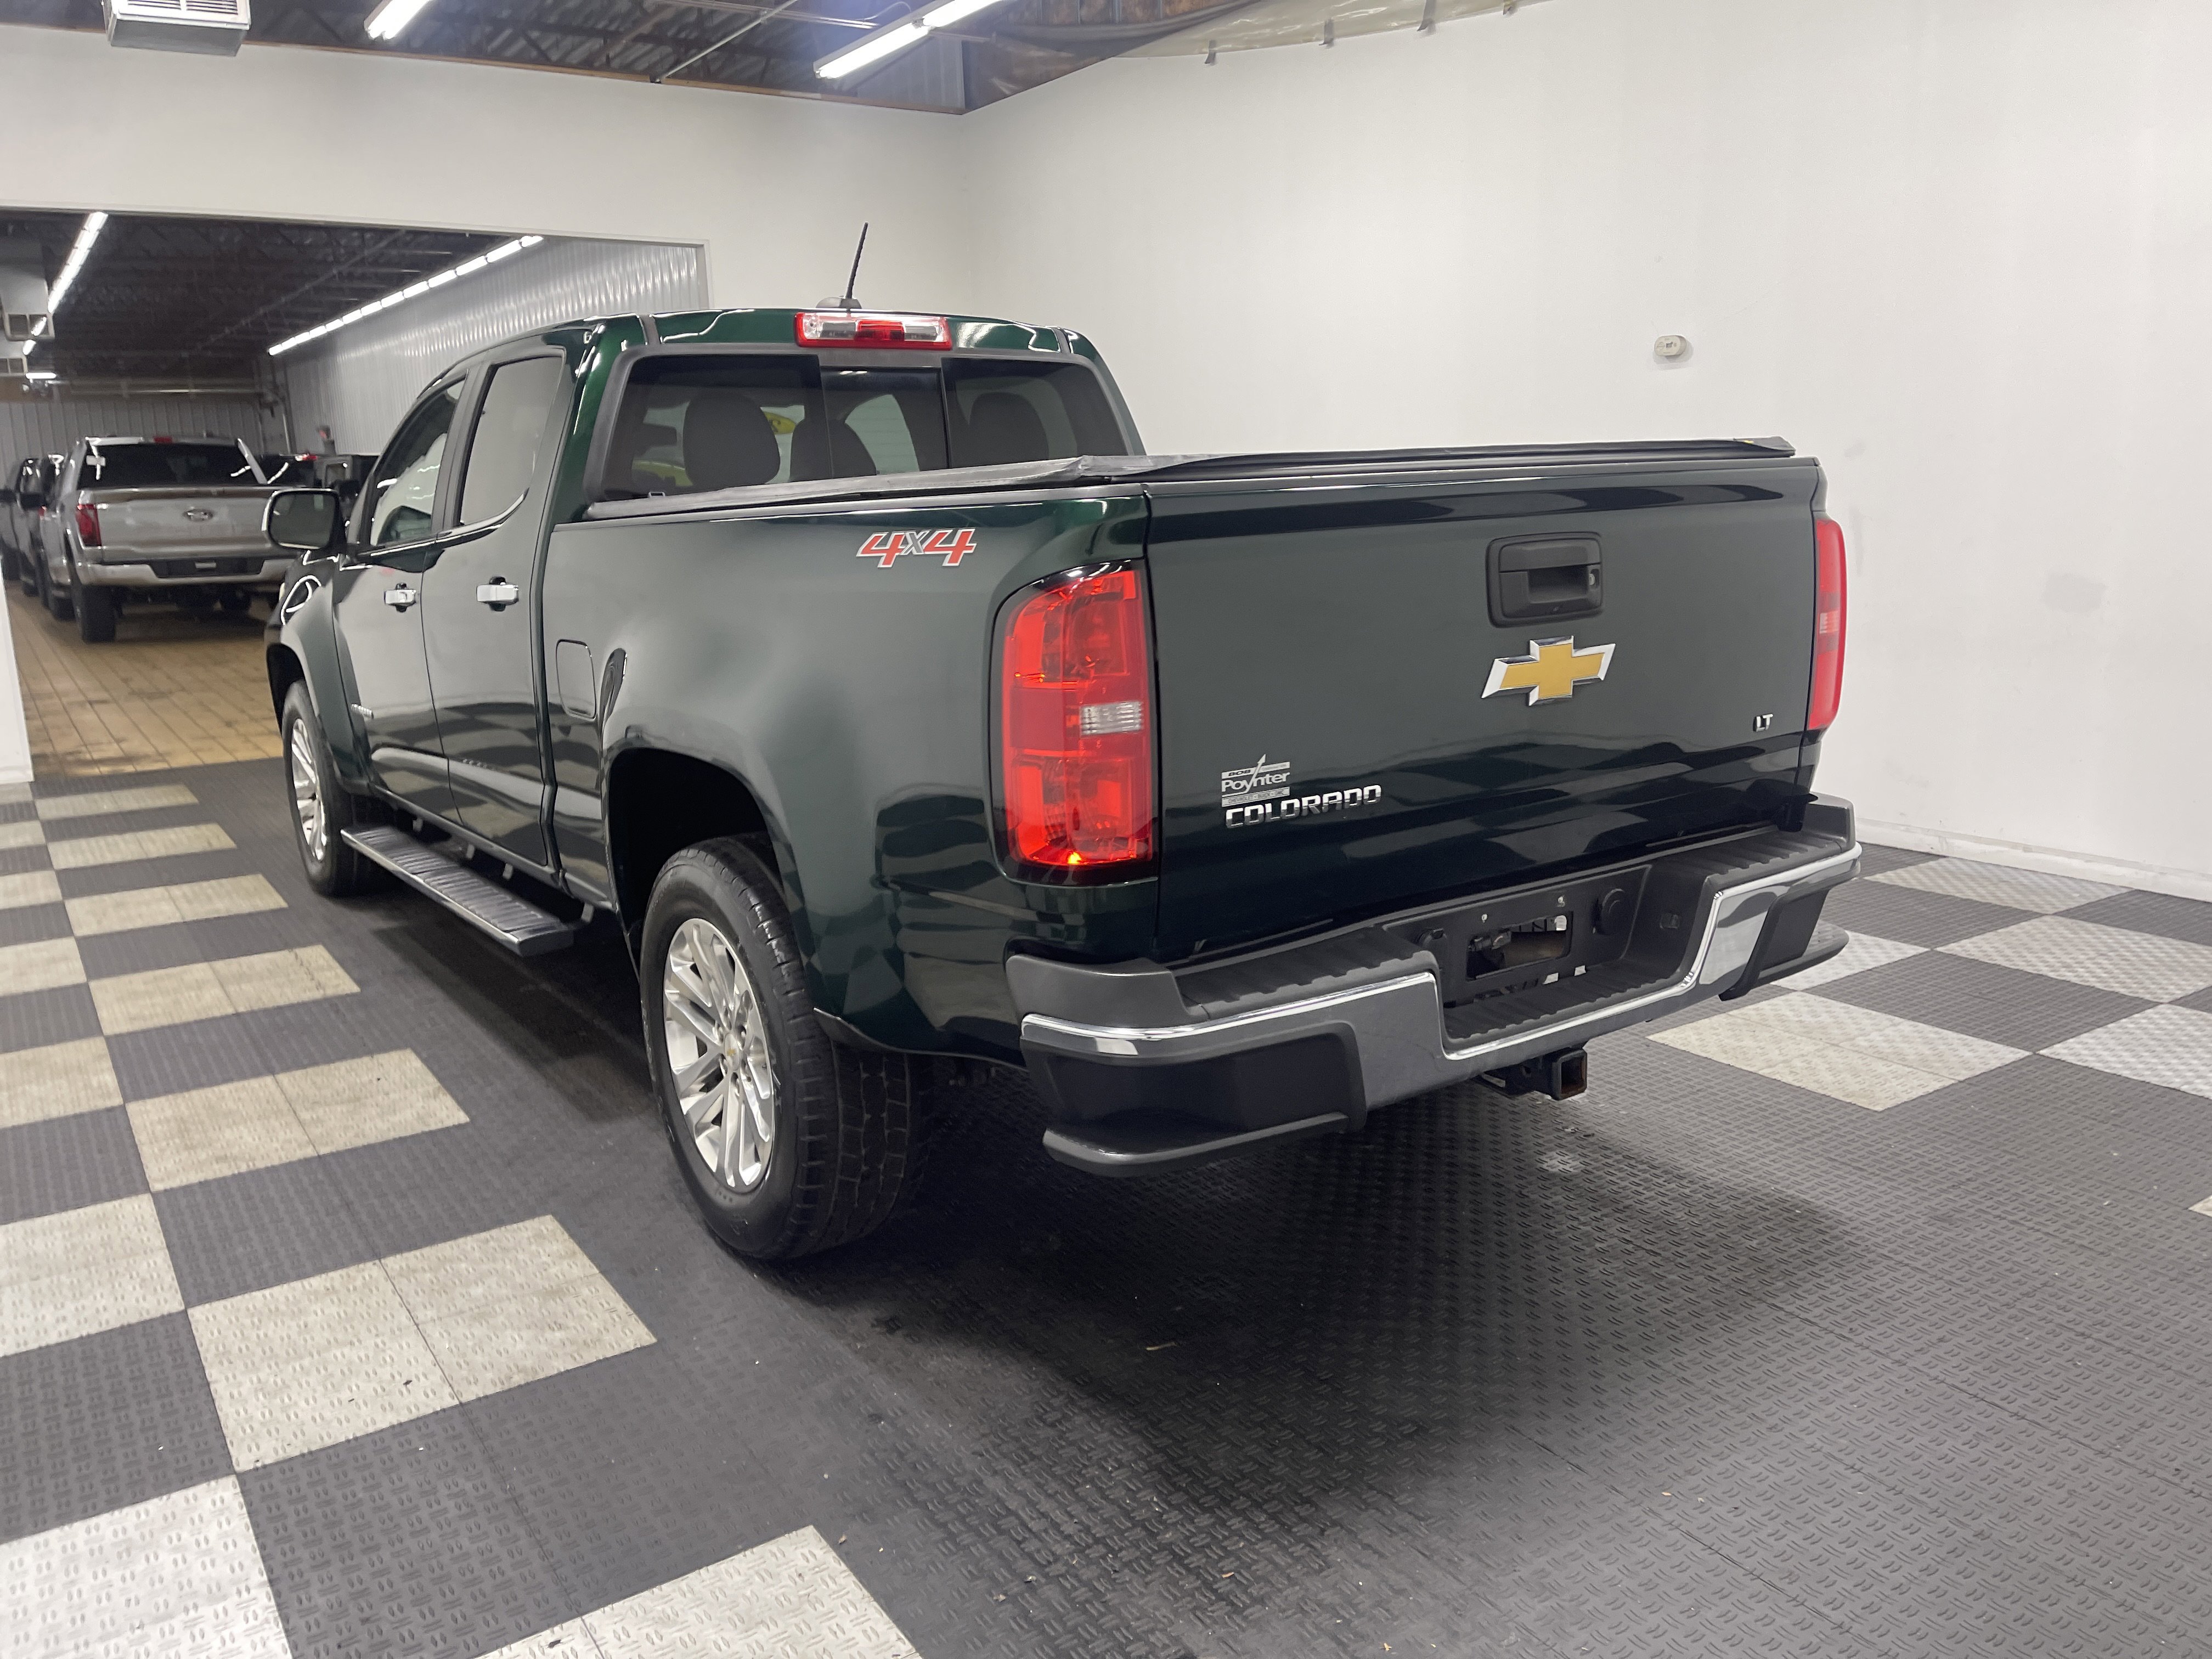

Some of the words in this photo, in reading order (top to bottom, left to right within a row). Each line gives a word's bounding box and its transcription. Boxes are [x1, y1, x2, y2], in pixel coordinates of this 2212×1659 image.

[1755, 713, 1774, 732] LT
[1221, 771, 1290, 793] Poynter
[1226, 785, 1381, 828] COLORADO
